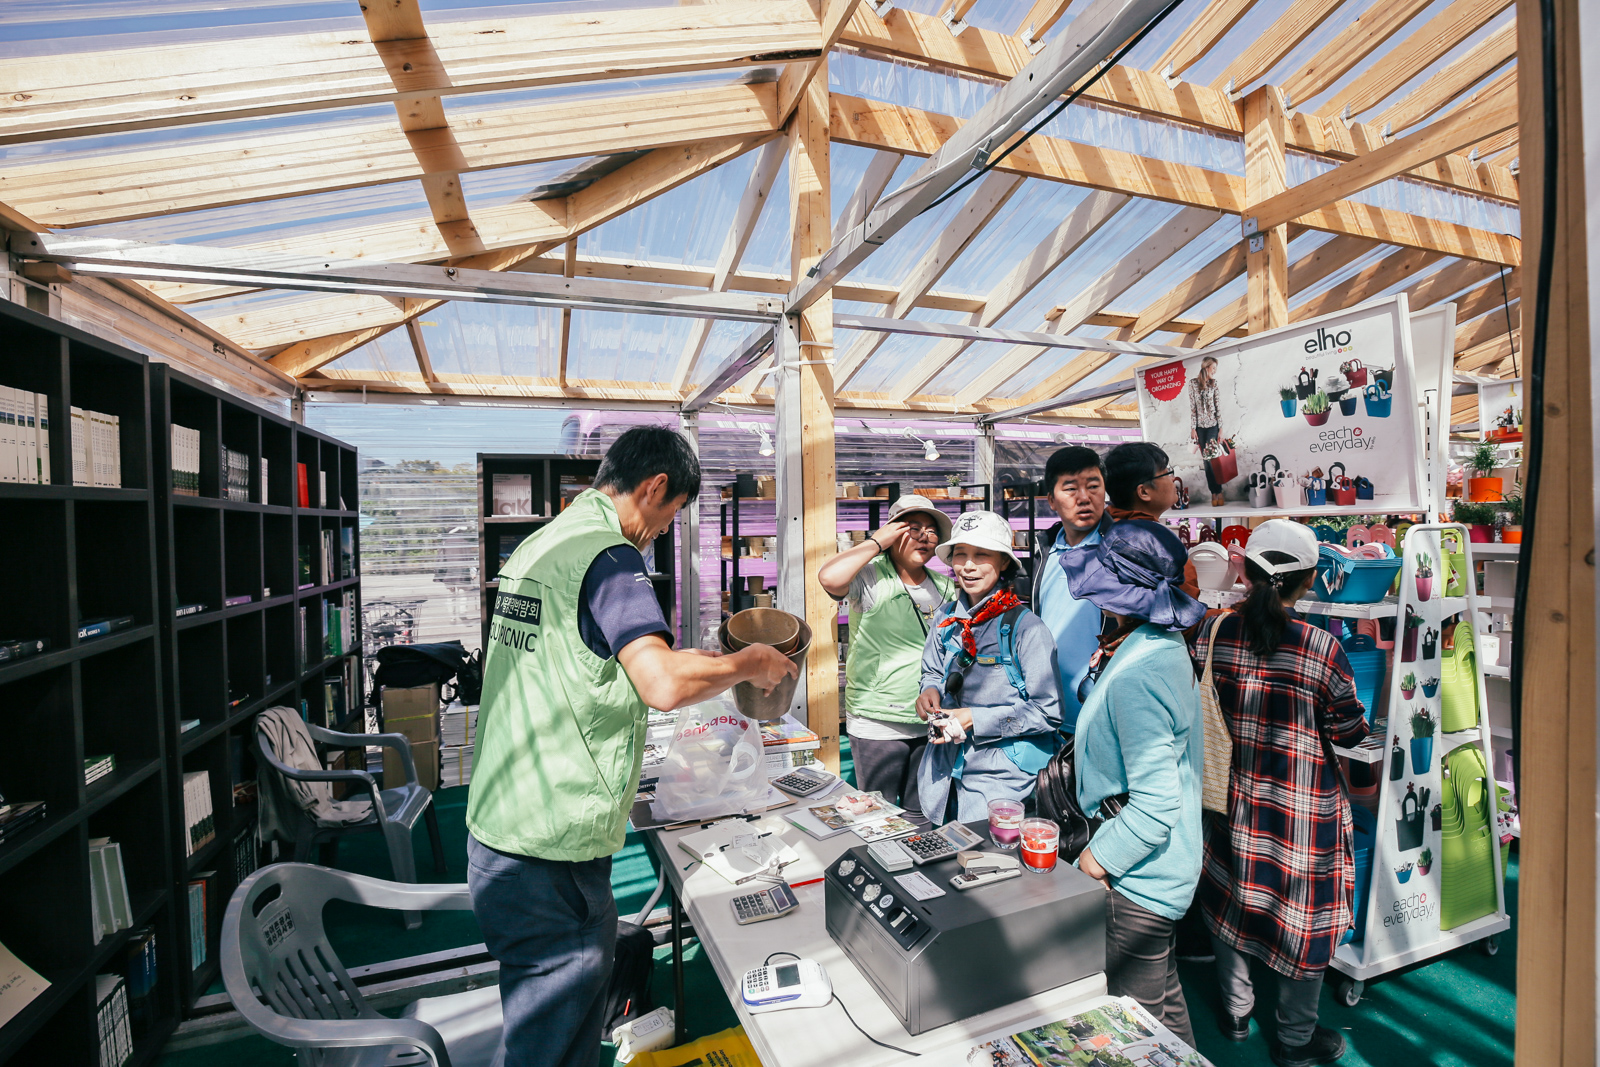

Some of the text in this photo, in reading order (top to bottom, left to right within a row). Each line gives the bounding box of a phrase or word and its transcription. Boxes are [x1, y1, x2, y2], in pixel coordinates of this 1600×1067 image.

[1304, 327, 1351, 354] elho
[1151, 367, 1179, 379] YOUR HAPPY
[1151, 381, 1182, 393] ORGANIZING
[1309, 436, 1372, 453] everyday
[1383, 902, 1432, 928] everyday
